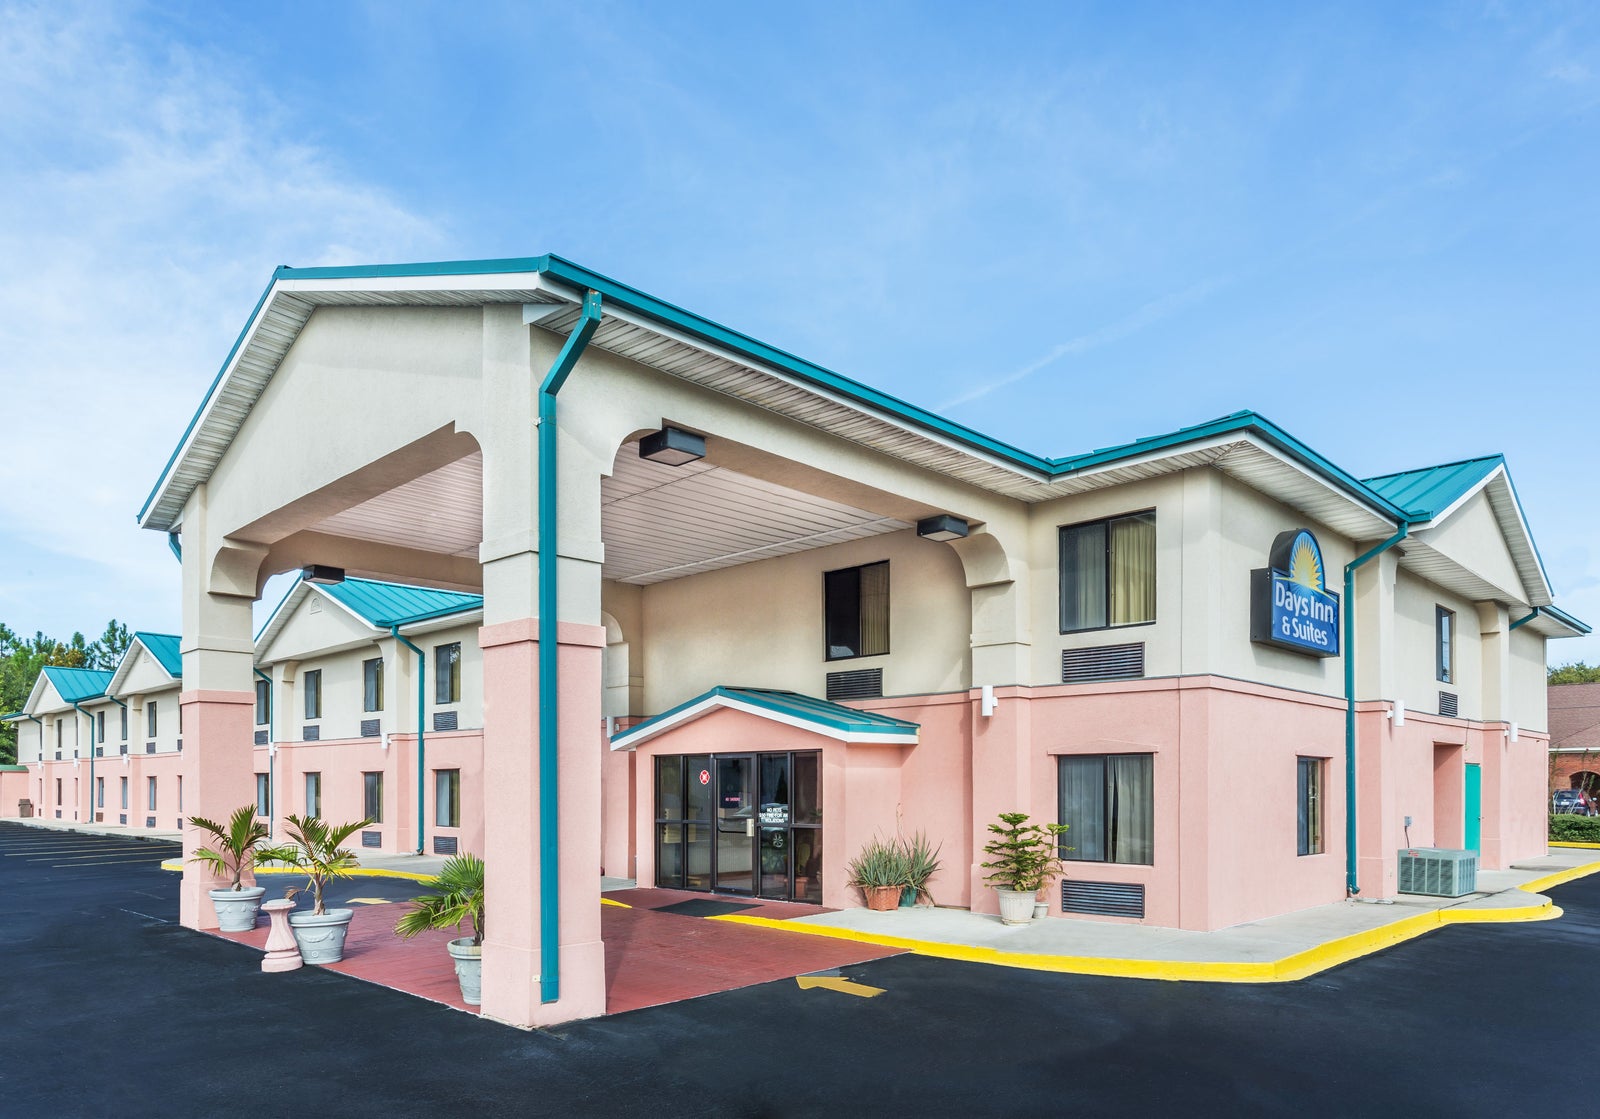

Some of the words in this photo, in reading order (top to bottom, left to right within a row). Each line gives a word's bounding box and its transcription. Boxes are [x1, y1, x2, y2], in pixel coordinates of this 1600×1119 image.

[1275, 581, 1309, 616] Days
[1310, 596, 1334, 623] Inn
[1282, 616, 1290, 635] &
[1292, 617, 1328, 645] Suites
